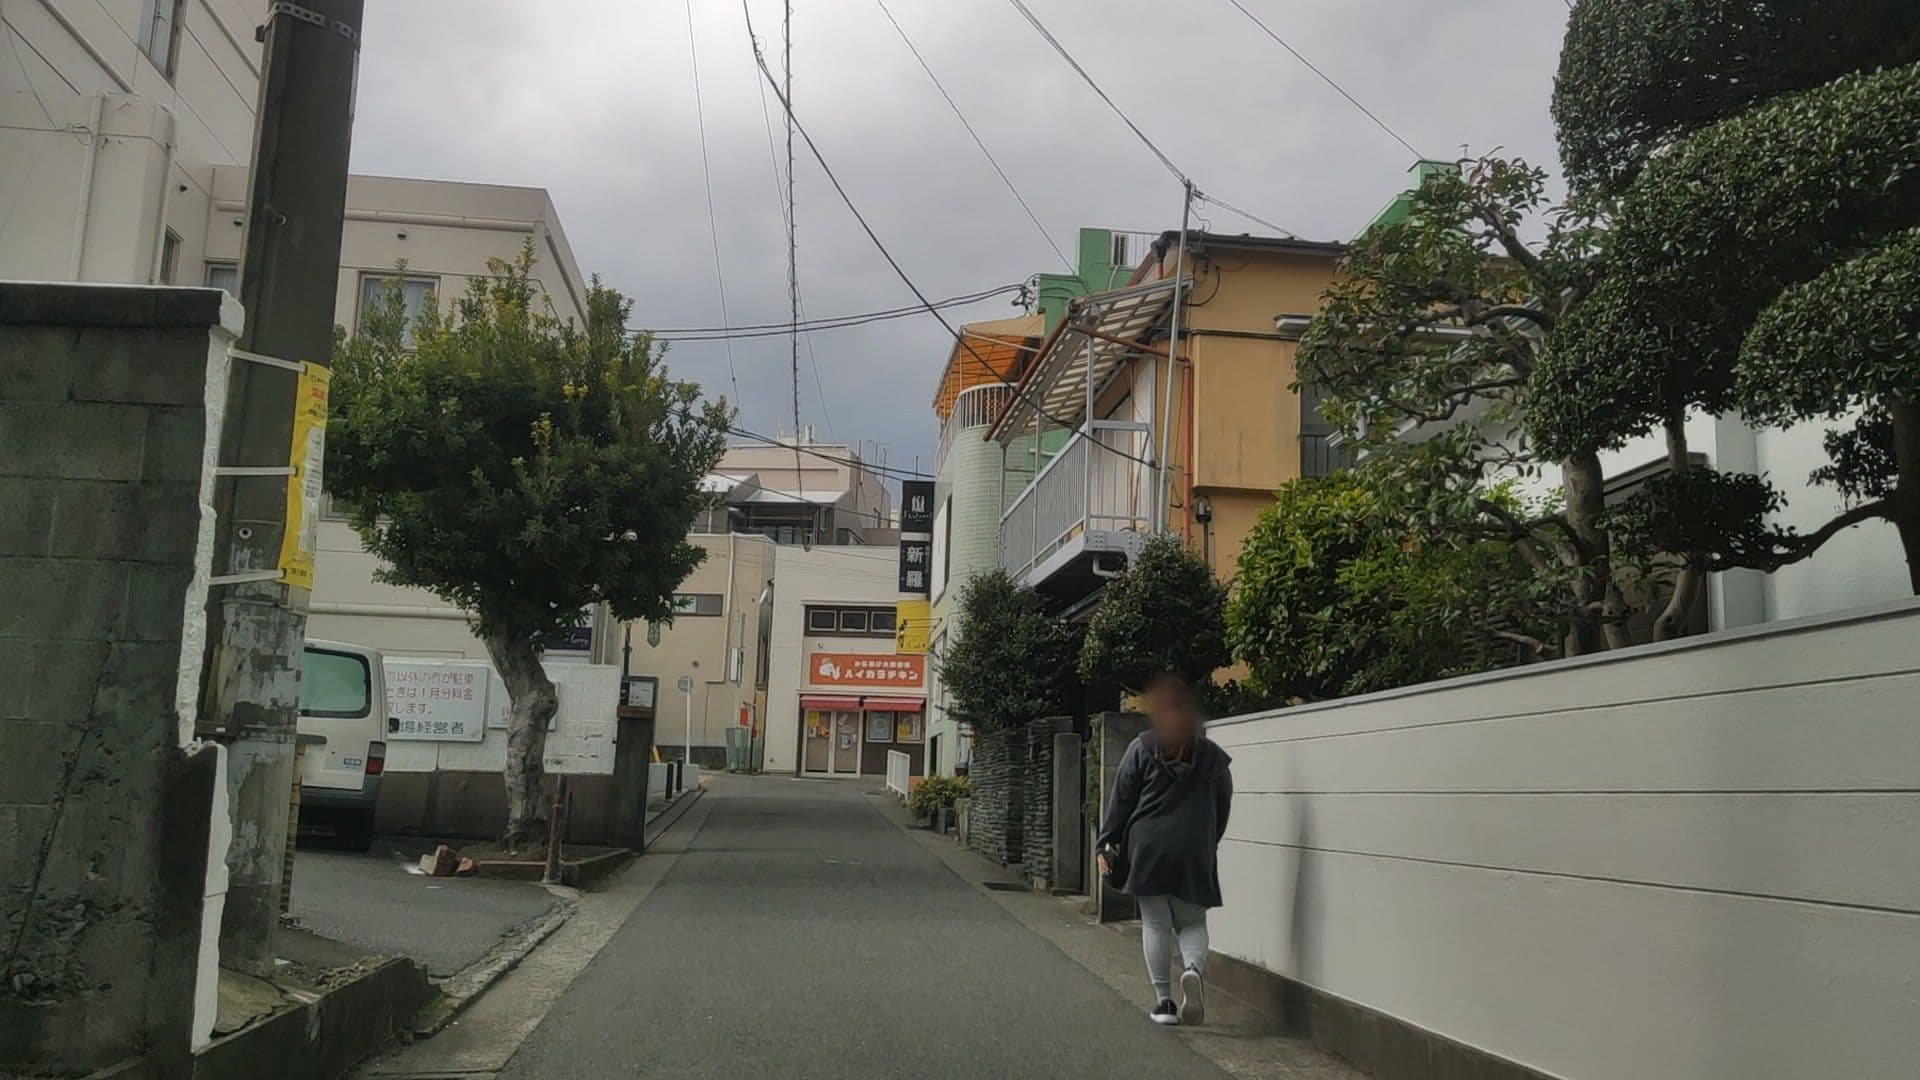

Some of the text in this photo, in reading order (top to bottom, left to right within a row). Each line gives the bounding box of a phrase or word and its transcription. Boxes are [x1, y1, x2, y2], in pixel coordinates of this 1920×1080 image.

[844, 669, 918, 680] ハイカラチキン
